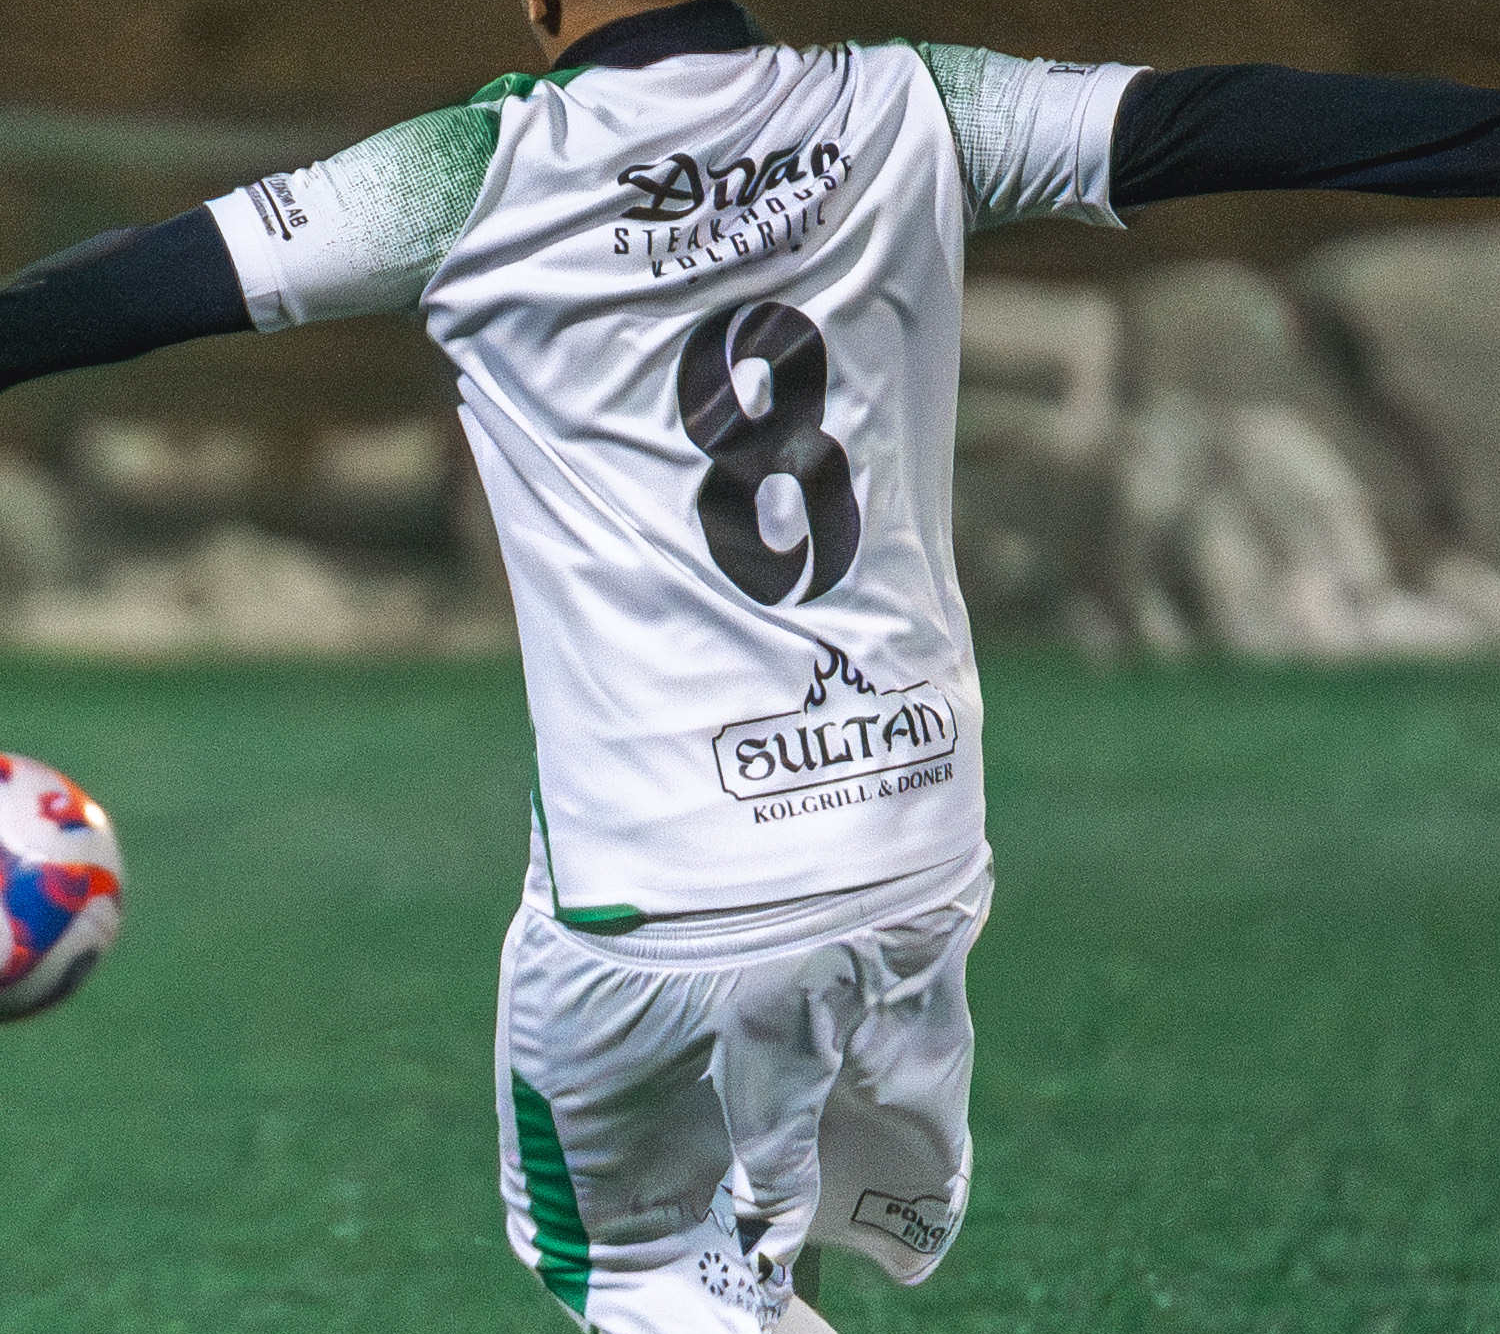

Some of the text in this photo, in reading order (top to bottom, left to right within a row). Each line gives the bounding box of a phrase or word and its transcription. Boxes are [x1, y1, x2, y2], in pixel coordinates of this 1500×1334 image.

[285, 208, 309, 228] AB
[676, 300, 862, 607] 8
[735, 701, 947, 781] SULTAN
[752, 784, 874, 825] KOLGRILL
[877, 778, 894, 798] &
